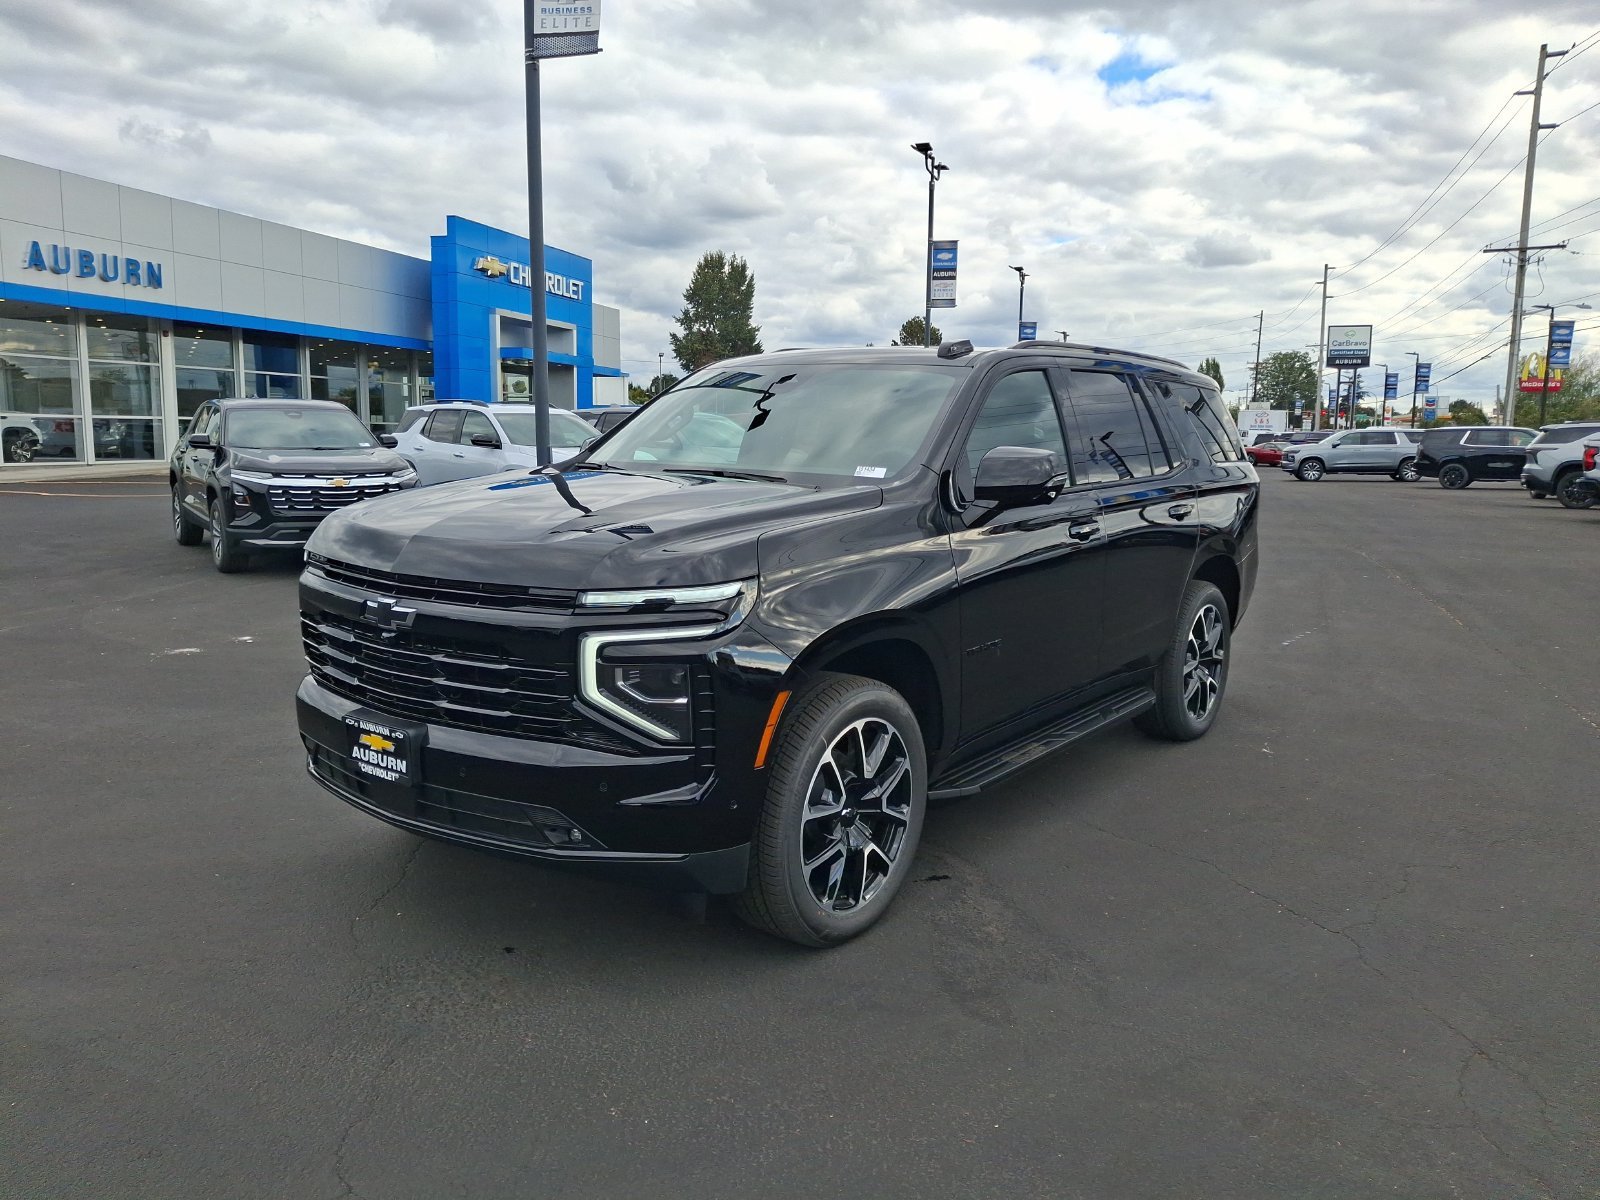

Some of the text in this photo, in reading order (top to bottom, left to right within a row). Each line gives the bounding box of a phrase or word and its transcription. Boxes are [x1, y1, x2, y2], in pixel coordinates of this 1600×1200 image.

[541, 6, 592, 14] BUSINESS
[540, 17, 592, 28] ELITE
[22, 240, 163, 290] AUBURN
[360, 721, 390, 736] AUBURN
[351, 746, 407, 773] AUBURN
